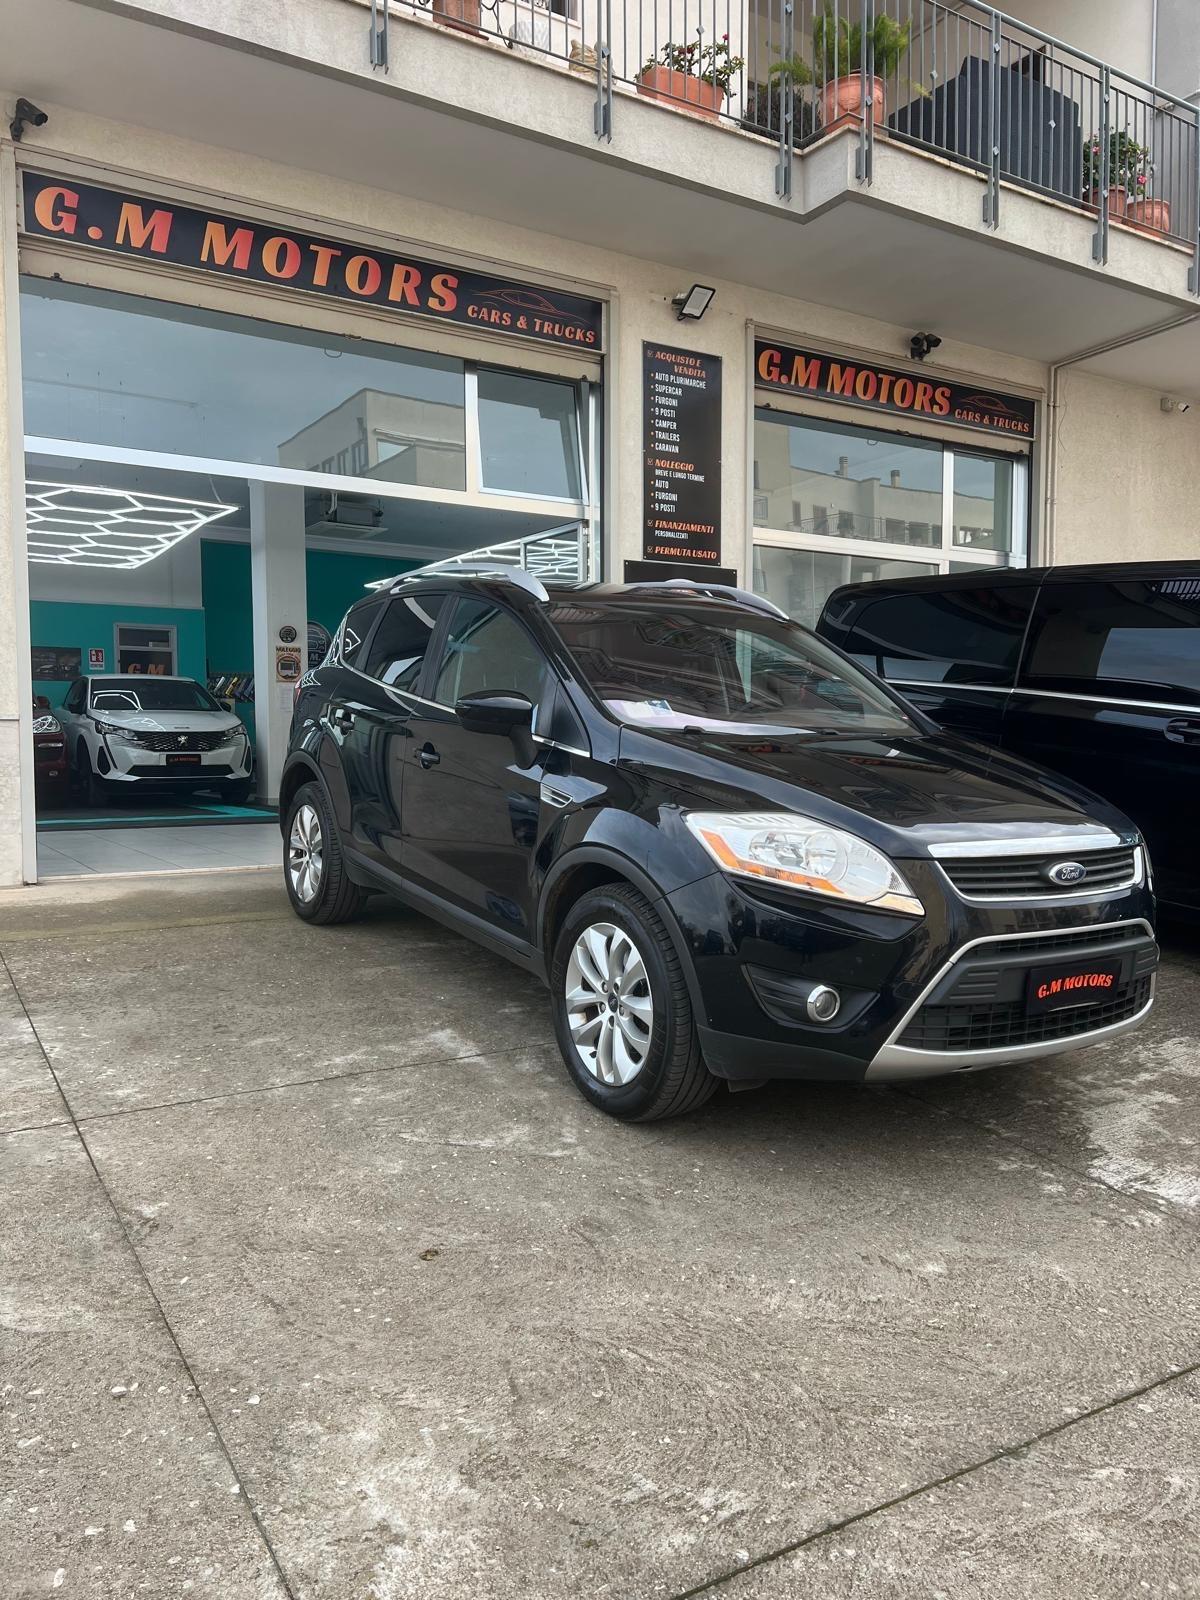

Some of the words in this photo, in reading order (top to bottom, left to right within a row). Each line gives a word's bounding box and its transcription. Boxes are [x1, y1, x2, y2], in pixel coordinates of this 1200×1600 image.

[34, 186, 174, 254] G.M
[200, 220, 459, 313] MOTORS
[467, 304, 511, 326] CARS
[516, 314, 528, 329] &
[533, 317, 596, 344] TRUCKS
[655, 351, 695, 366] ACQUISTO
[695, 359, 702, 367] E
[674, 365, 706, 378] VENDITA
[655, 372, 669, 382] AUTO
[670, 374, 706, 389] PLURIMARCHE
[758, 349, 822, 390] G.M
[826, 363, 952, 417] MOTORS
[655, 383, 682, 396] SUPERCAR
[655, 395, 678, 407] FURGONI
[655, 407, 659, 415] 9
[660, 408, 676, 418] POSTI
[655, 419, 677, 430] CAMPER
[954, 408, 980, 425] CARS
[982, 414, 990, 425] &
[993, 415, 1030, 433] TRUCKS
[655, 430, 680, 442] TRAILERS
[655, 442, 679, 454] CARAVAN
[655, 459, 694, 472] NOLEGGIO
[655, 479, 669, 489] AUTO
[655, 491, 678, 502] FURGONI
[655, 503, 659, 511] 9
[660, 503, 676, 513] POSTI
[655, 520, 715, 534] FINANZIAMENTI
[655, 530, 689, 540] PERSONALIZZATI
[655, 546, 691, 557] PERMUTA
[692, 549, 717, 560] USATO
[1061, 867, 1080, 880] Ford
[1038, 979, 1062, 999] G.M
[1063, 974, 1114, 991] MOTORS
